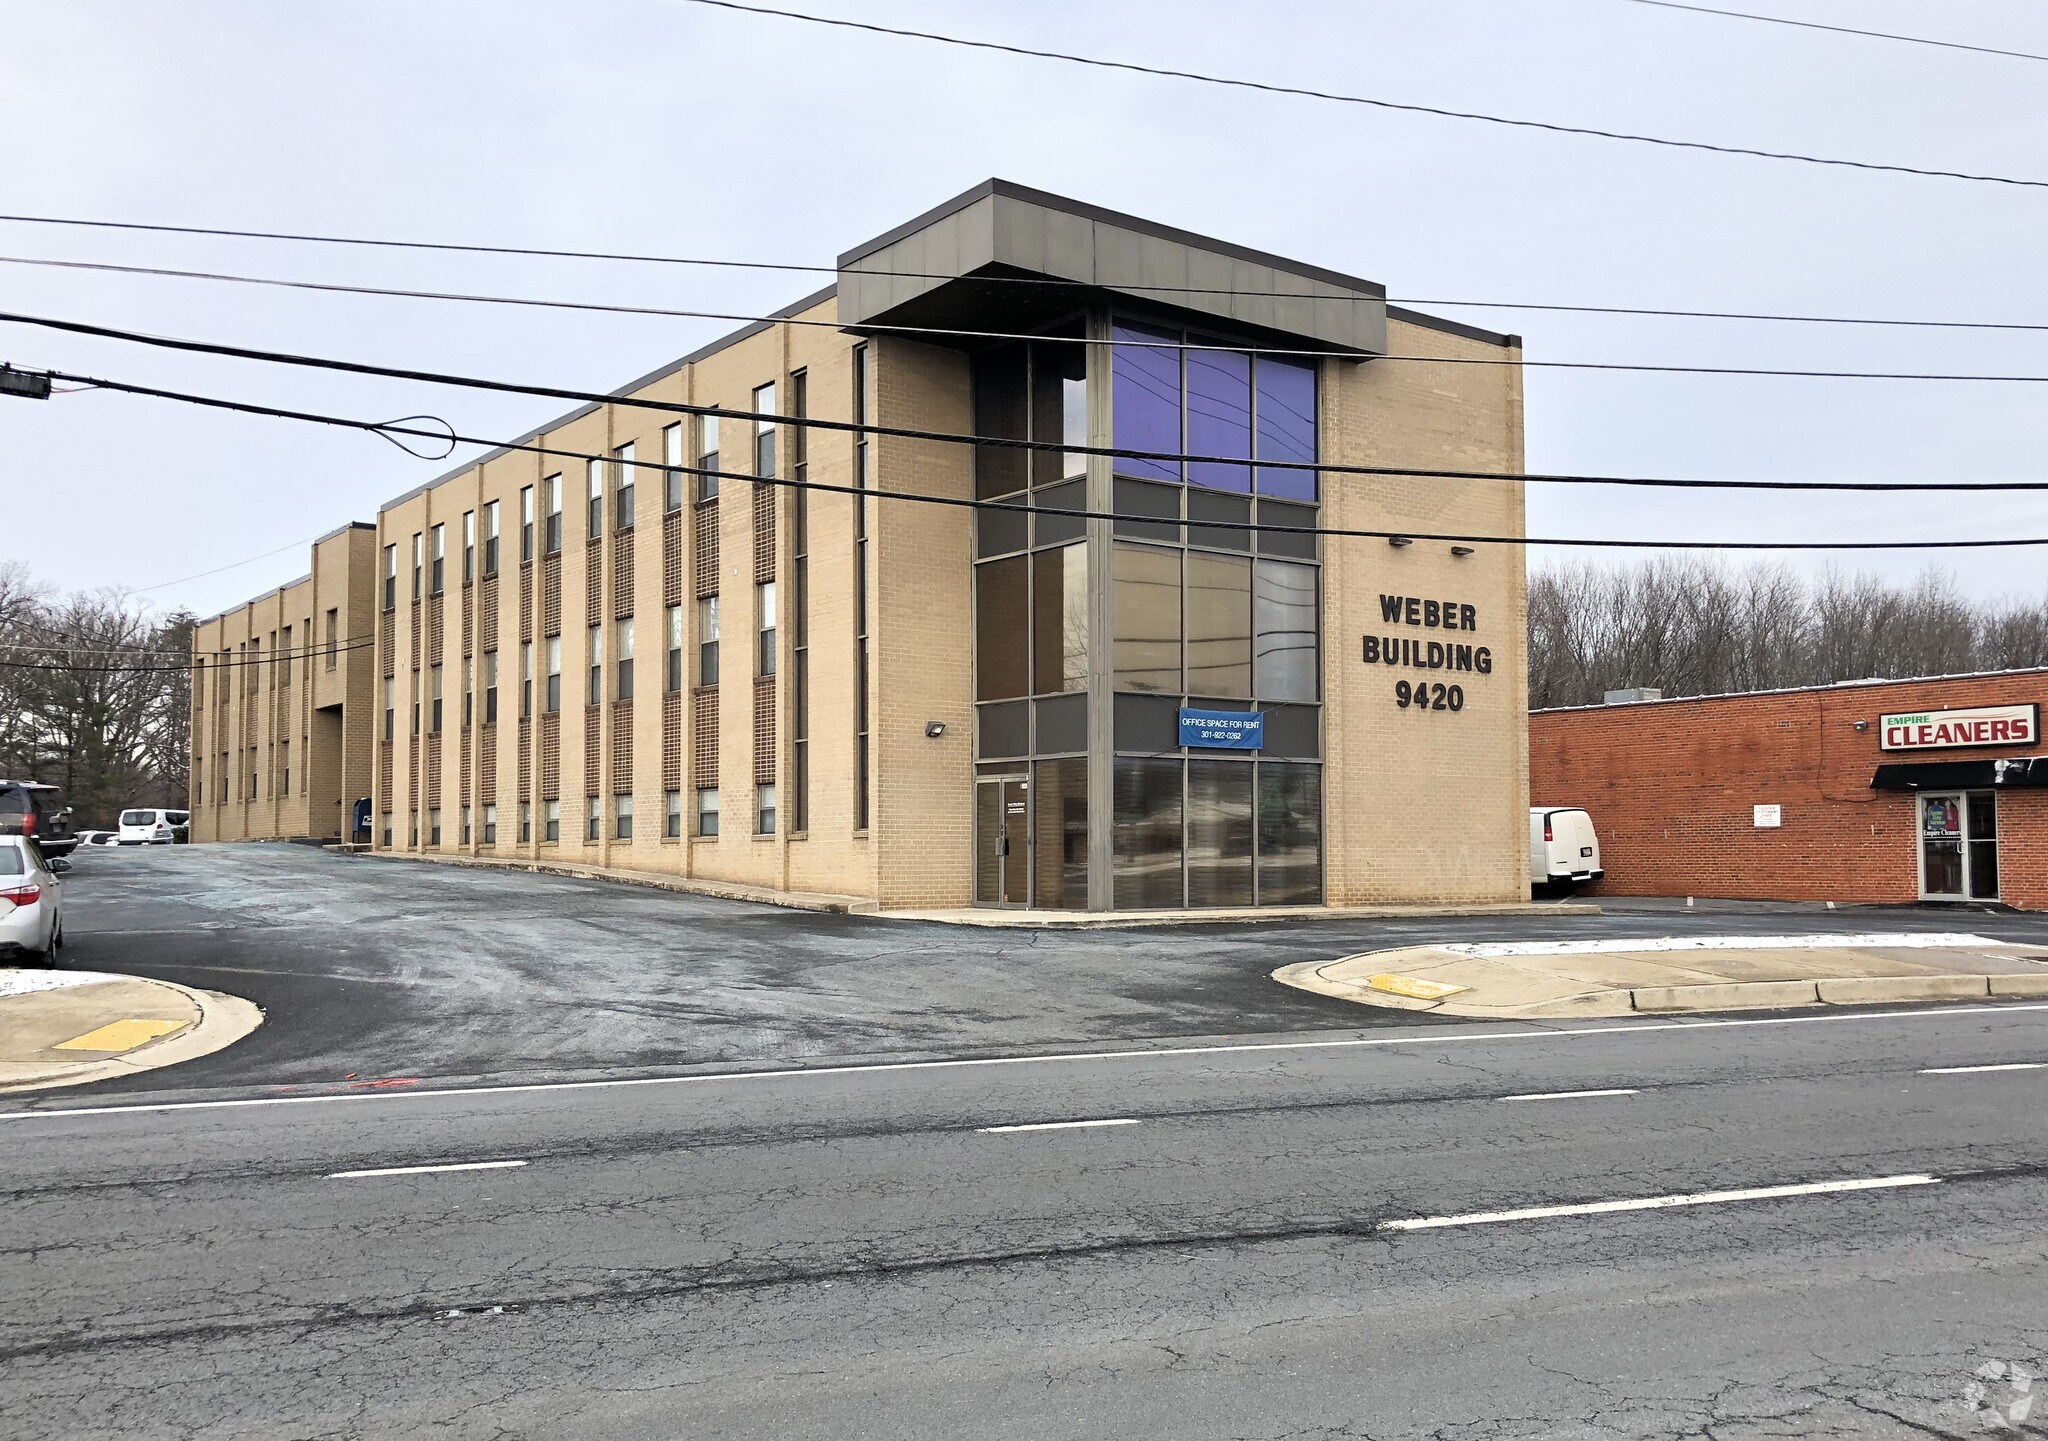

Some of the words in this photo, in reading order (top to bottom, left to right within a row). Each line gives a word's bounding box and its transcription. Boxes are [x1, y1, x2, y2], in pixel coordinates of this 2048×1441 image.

[1379, 594, 1476, 631] WEBER
[1362, 635, 1492, 674] BUILDING
[1395, 680, 1464, 711] 9420
[1182, 717, 1206, 727] OFFICE
[1206, 719, 1228, 728] SPACE
[1229, 720, 1242, 729] FOR
[1243, 721, 1260, 729] RENT
[1887, 715, 1930, 726] EMPIRE
[1887, 718, 2029, 747] CLEANERS
